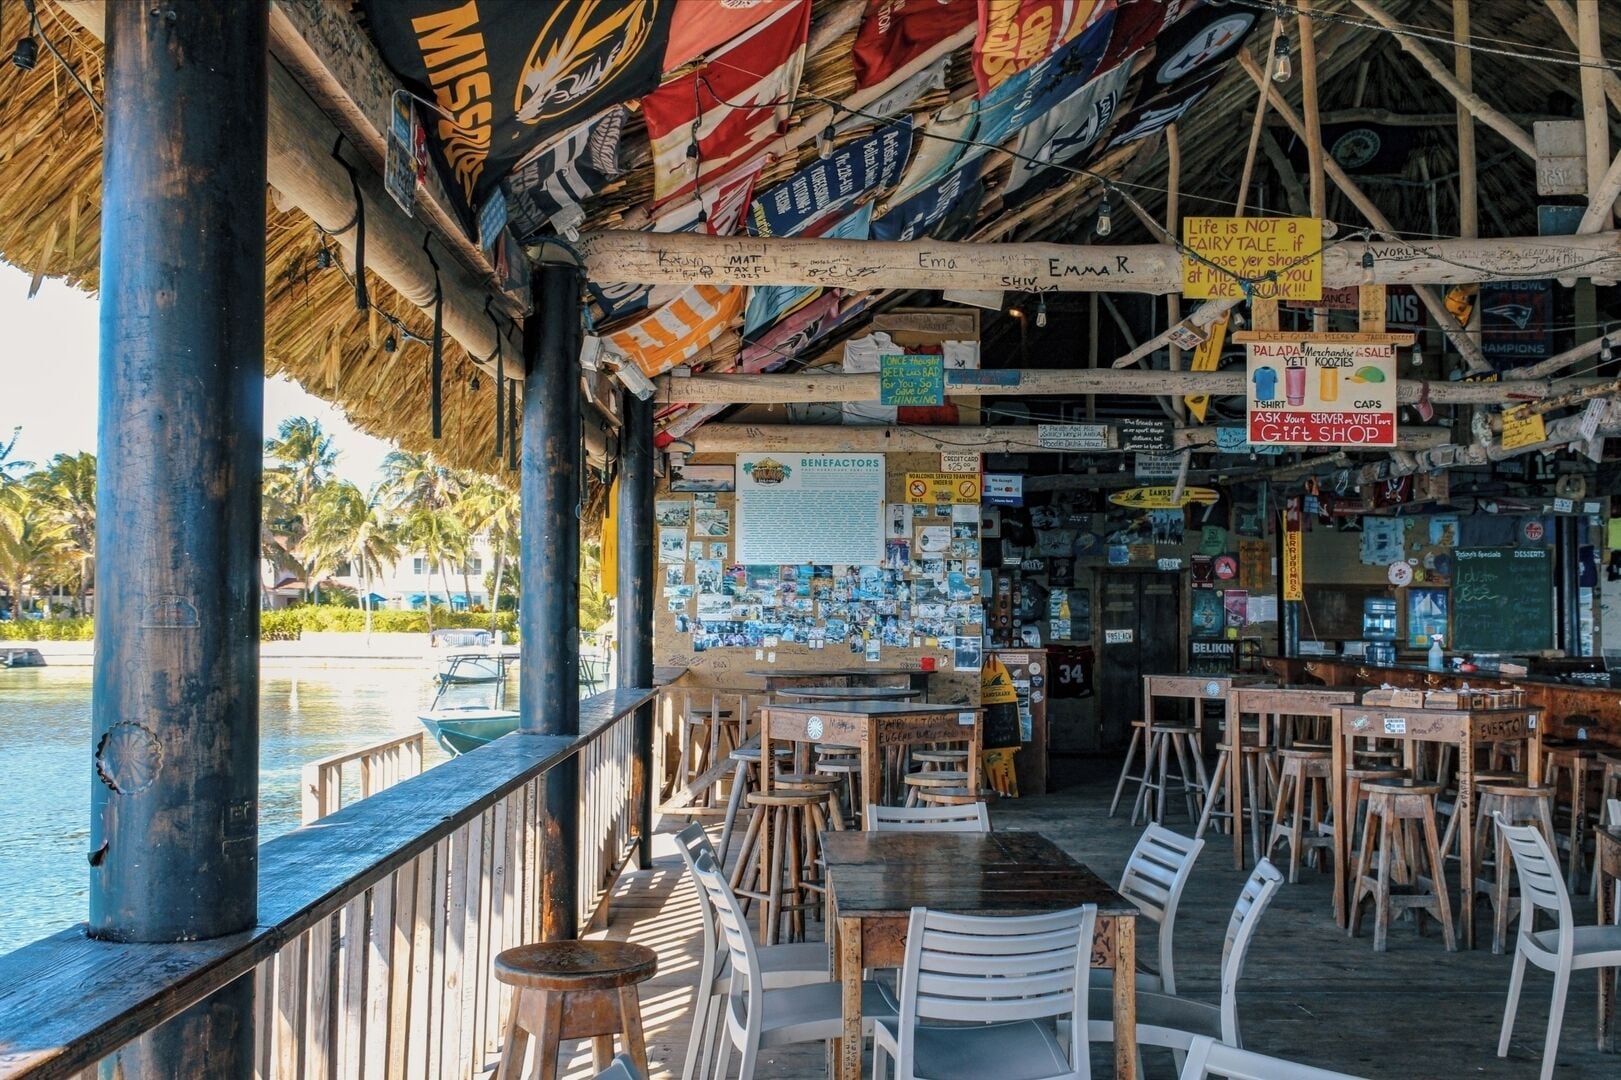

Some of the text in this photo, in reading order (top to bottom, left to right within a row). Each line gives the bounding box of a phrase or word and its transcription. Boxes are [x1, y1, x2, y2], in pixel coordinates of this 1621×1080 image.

[410, 0, 491, 208] MISSOURI
[1189, 219, 1297, 234] Life is NOT a
[1188, 236, 1233, 251] FAIRY
[1293, 234, 1305, 252] if
[919, 252, 957, 269] Ema
[1241, 256, 1263, 270] yer
[754, 265, 770, 273] FL
[1187, 267, 1203, 283] at
[1207, 283, 1237, 297] ARE
[1480, 281, 1546, 290] UPER BOWL
[1253, 345, 1301, 357] PALAPA
[1364, 347, 1391, 358] SALE
[1480, 344, 1545, 353] HAMPIONS
[886, 356, 908, 366] ONCE
[1283, 357, 1354, 367] YETI KOOZIES
[882, 367, 904, 377] BEER
[922, 367, 941, 377] BAD
[887, 395, 937, 404] THINKING
[1354, 400, 1382, 409] CAPS
[1254, 412, 1281, 422] ASK
[1310, 413, 1344, 425] SERVER
[1353, 414, 1381, 425] VISIT
[1261, 423, 1312, 442] Gift
[1319, 425, 1379, 443] SHOP
[800, 458, 879, 468] BENEFACTORS
[1514, 550, 1545, 558] DESSERTS
[1192, 642, 1234, 653] BELIKIN
[1059, 664, 1084, 684] 34
